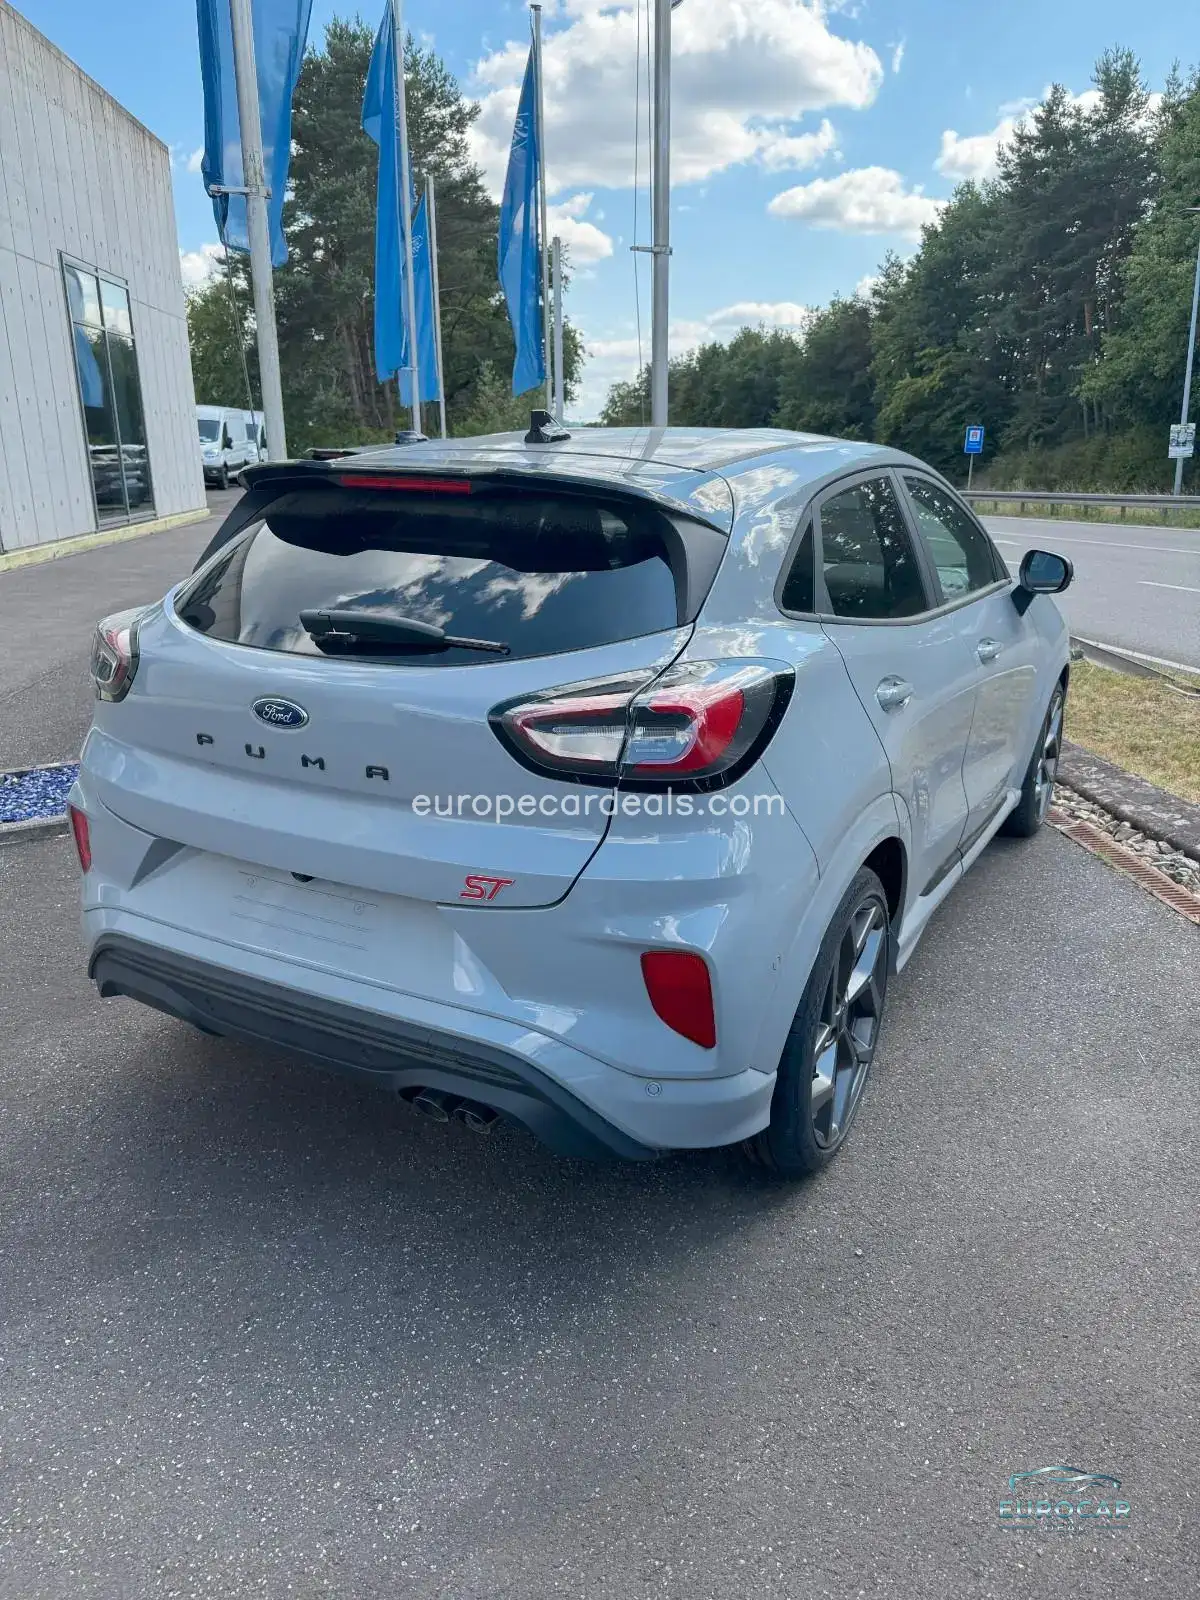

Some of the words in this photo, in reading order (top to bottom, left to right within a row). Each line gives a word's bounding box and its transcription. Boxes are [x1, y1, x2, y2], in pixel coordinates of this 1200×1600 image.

[263, 703, 293, 723] Ford
[196, 733, 390, 781] PUMA
[459, 874, 516, 901] ST
